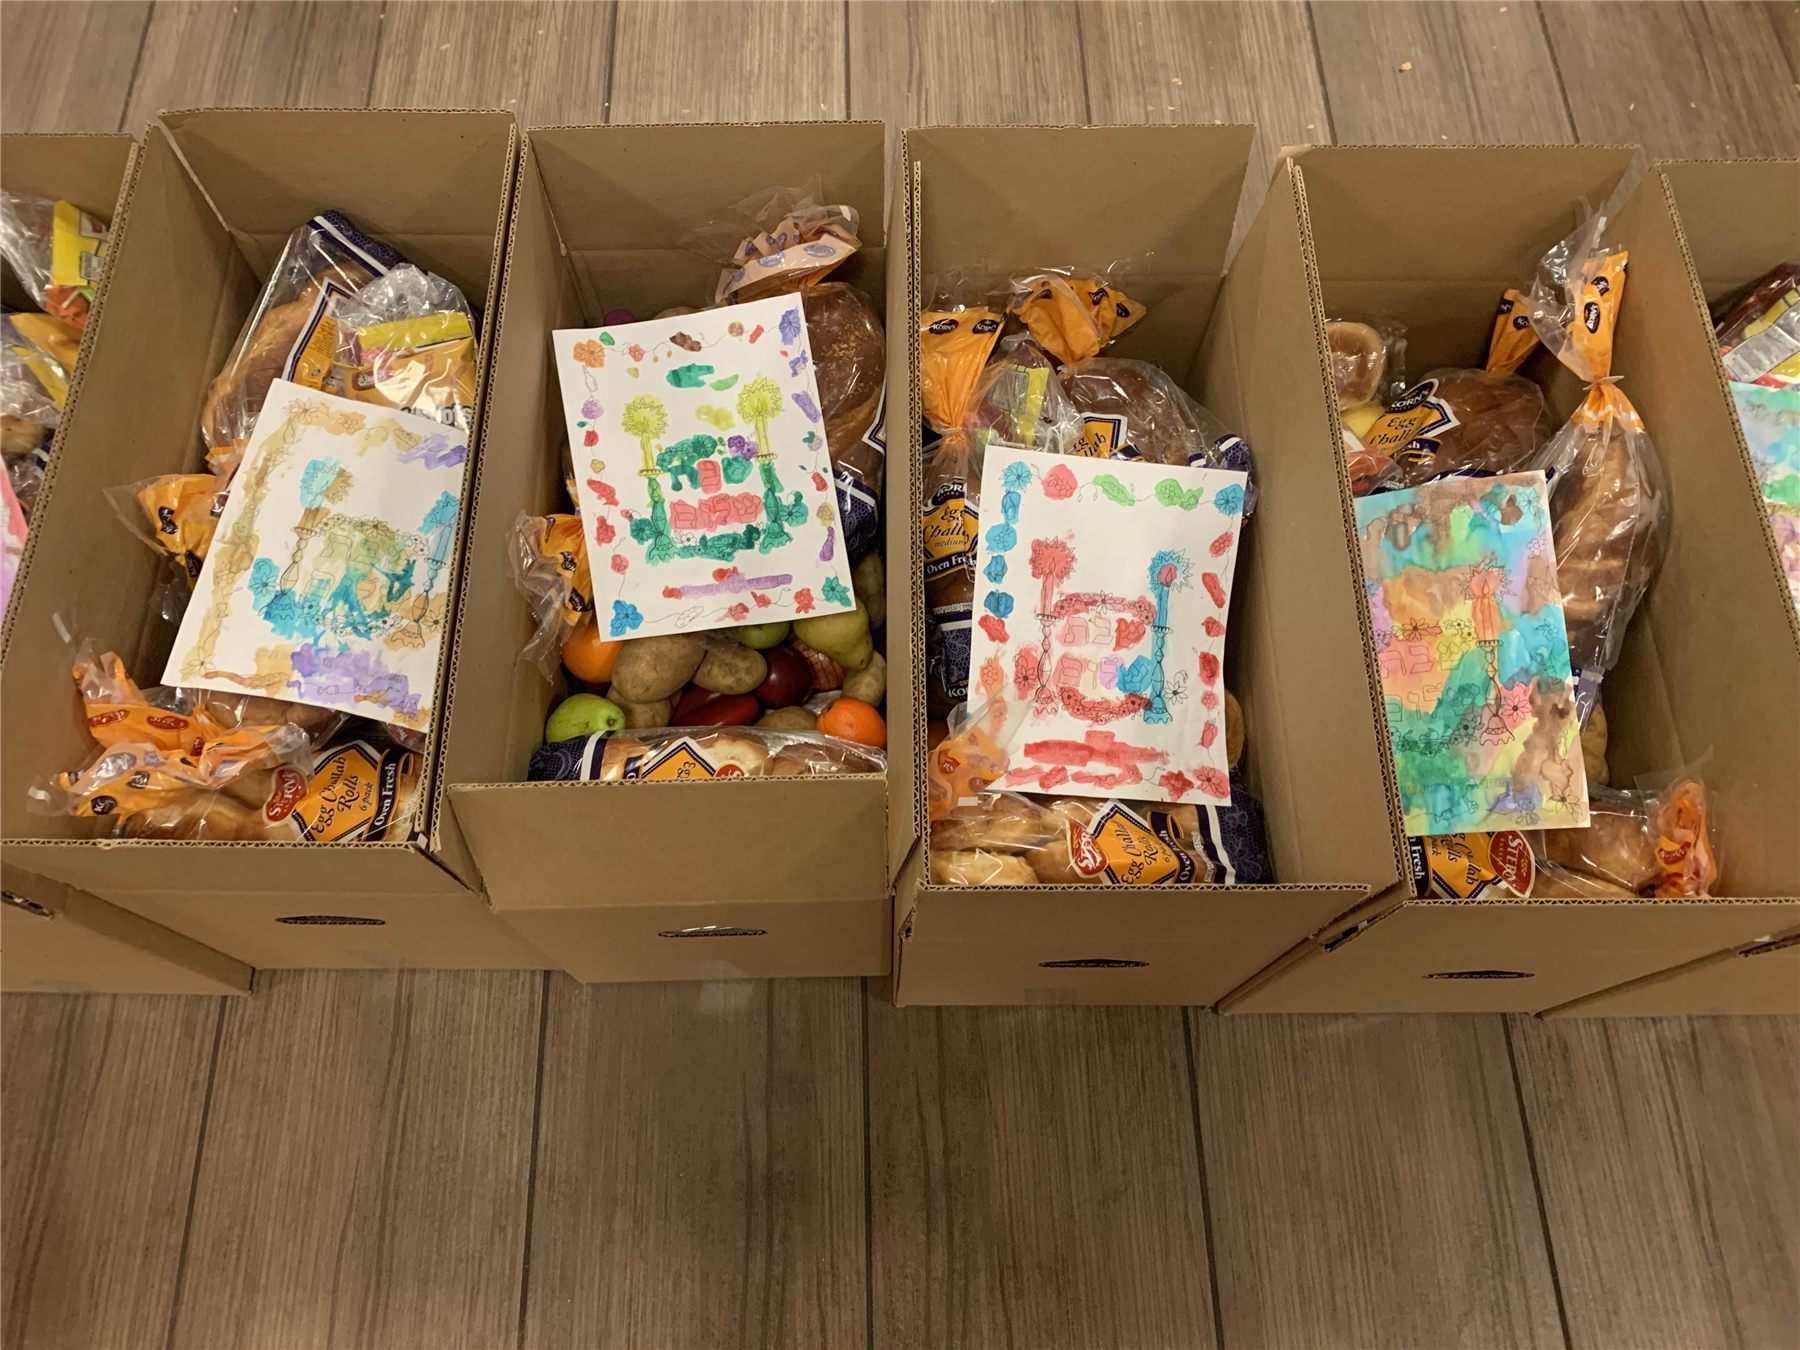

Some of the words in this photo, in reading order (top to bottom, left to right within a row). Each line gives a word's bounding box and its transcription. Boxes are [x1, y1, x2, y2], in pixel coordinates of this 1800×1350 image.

[1369, 429, 1413, 447] Chall
[1386, 417, 1417, 430] Egg
[926, 560, 951, 576] Oven
[1063, 616, 1147, 652] שבת
[1058, 655, 1149, 693] שלום
[318, 756, 347, 803] Challah
[381, 762, 397, 796] Fresh
[336, 774, 361, 814] Rolls
[360, 803, 368, 812] 6
[362, 781, 375, 807] pack
[310, 805, 336, 834] Egg
[373, 798, 393, 826] Oven
[1120, 860, 1145, 885] Egg
[1178, 852, 1194, 881] Oven
[1410, 845, 1426, 880] Fresh
